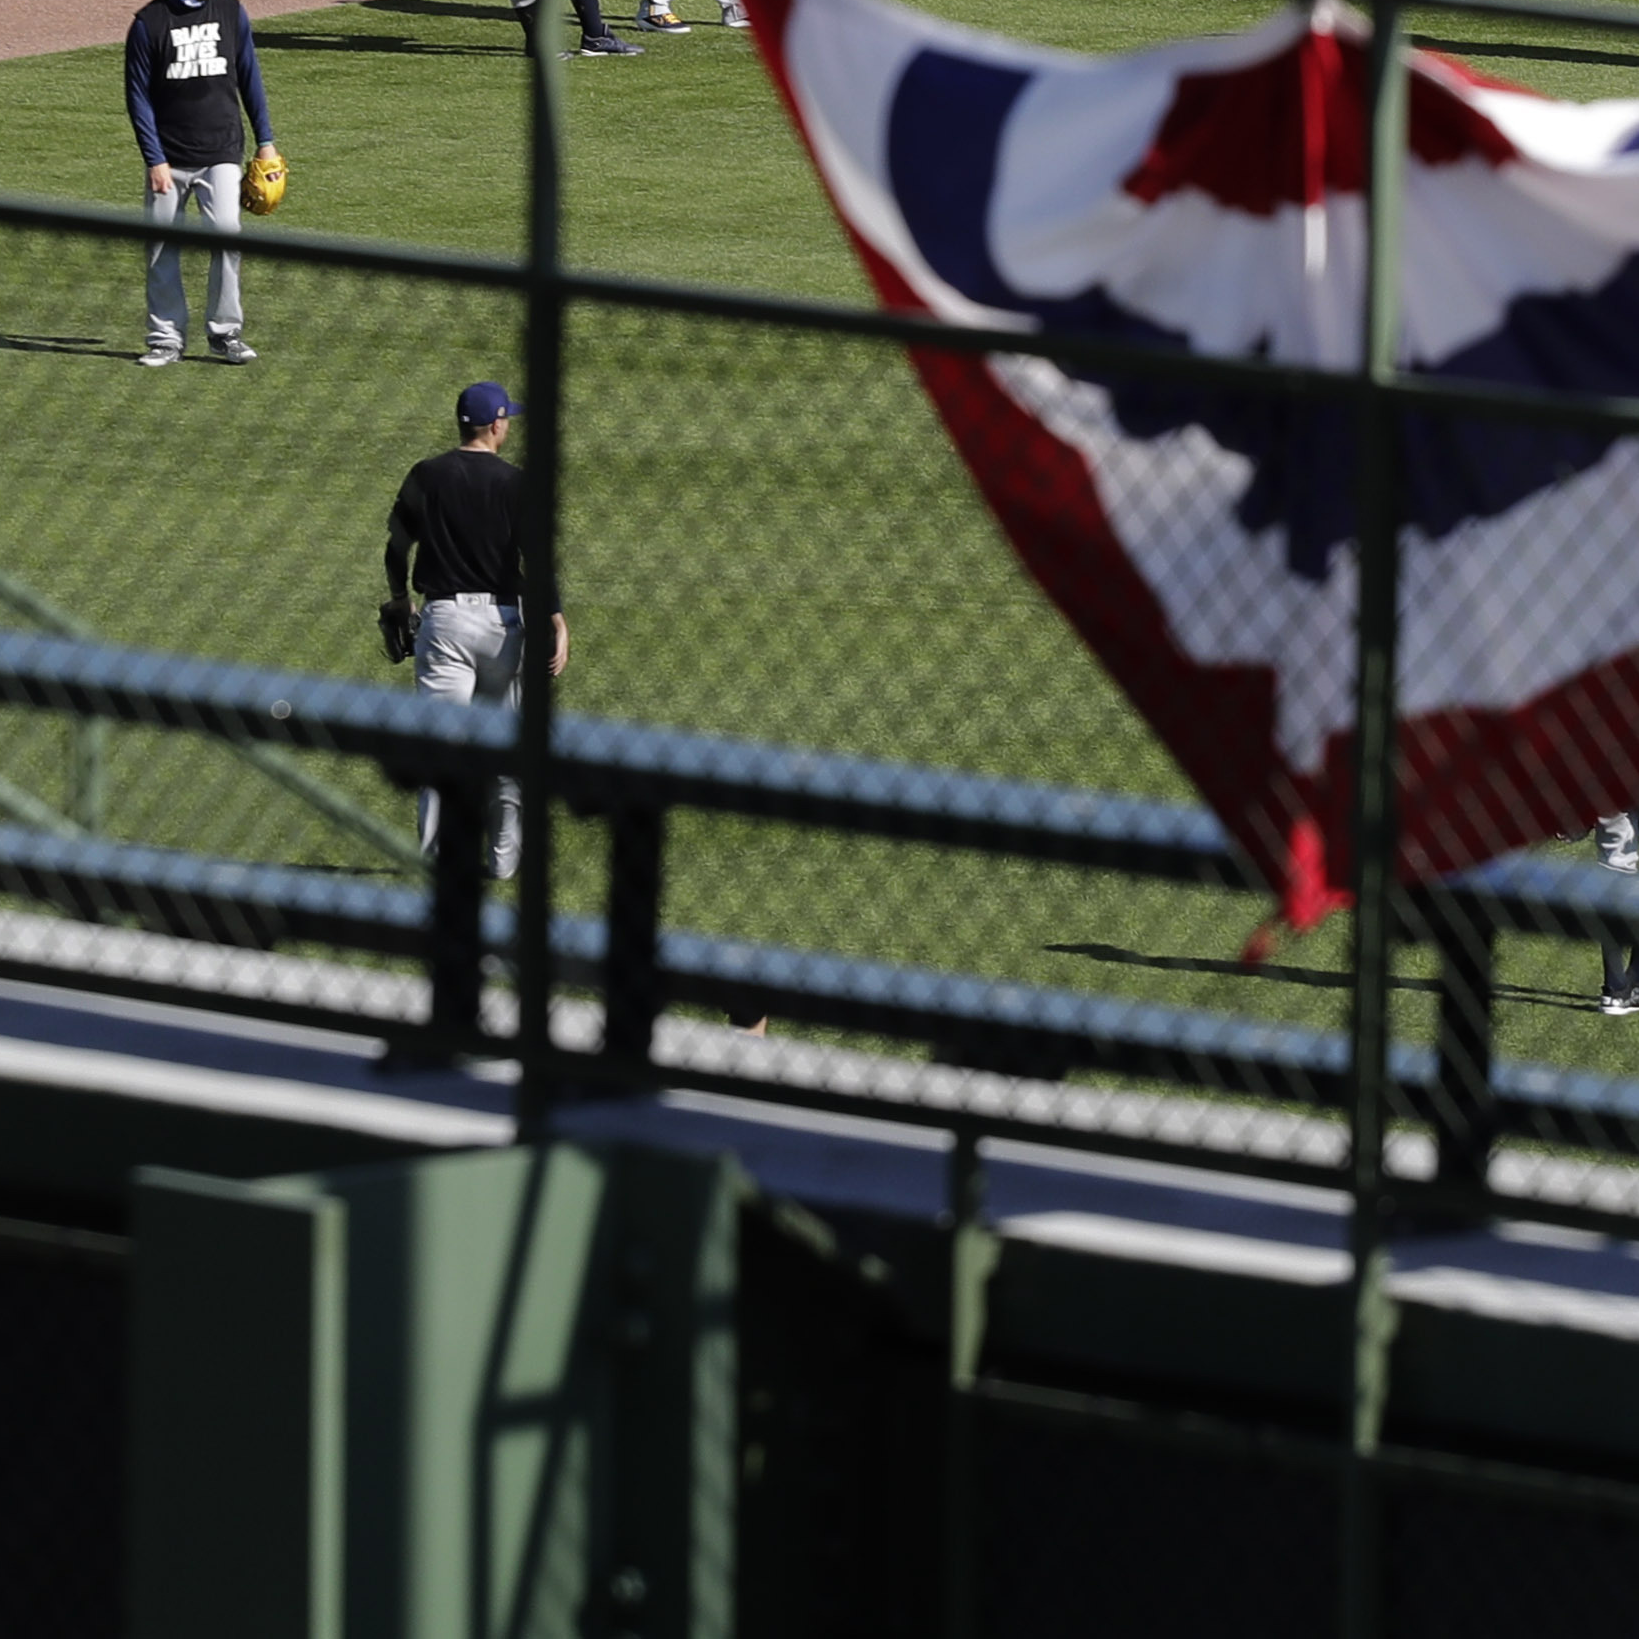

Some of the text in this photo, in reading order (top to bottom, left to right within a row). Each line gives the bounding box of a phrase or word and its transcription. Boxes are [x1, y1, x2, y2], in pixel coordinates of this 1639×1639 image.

[170, 22, 222, 47] BLACK
[177, 40, 218, 62] LIVES
[165, 56, 228, 80] MATTER
